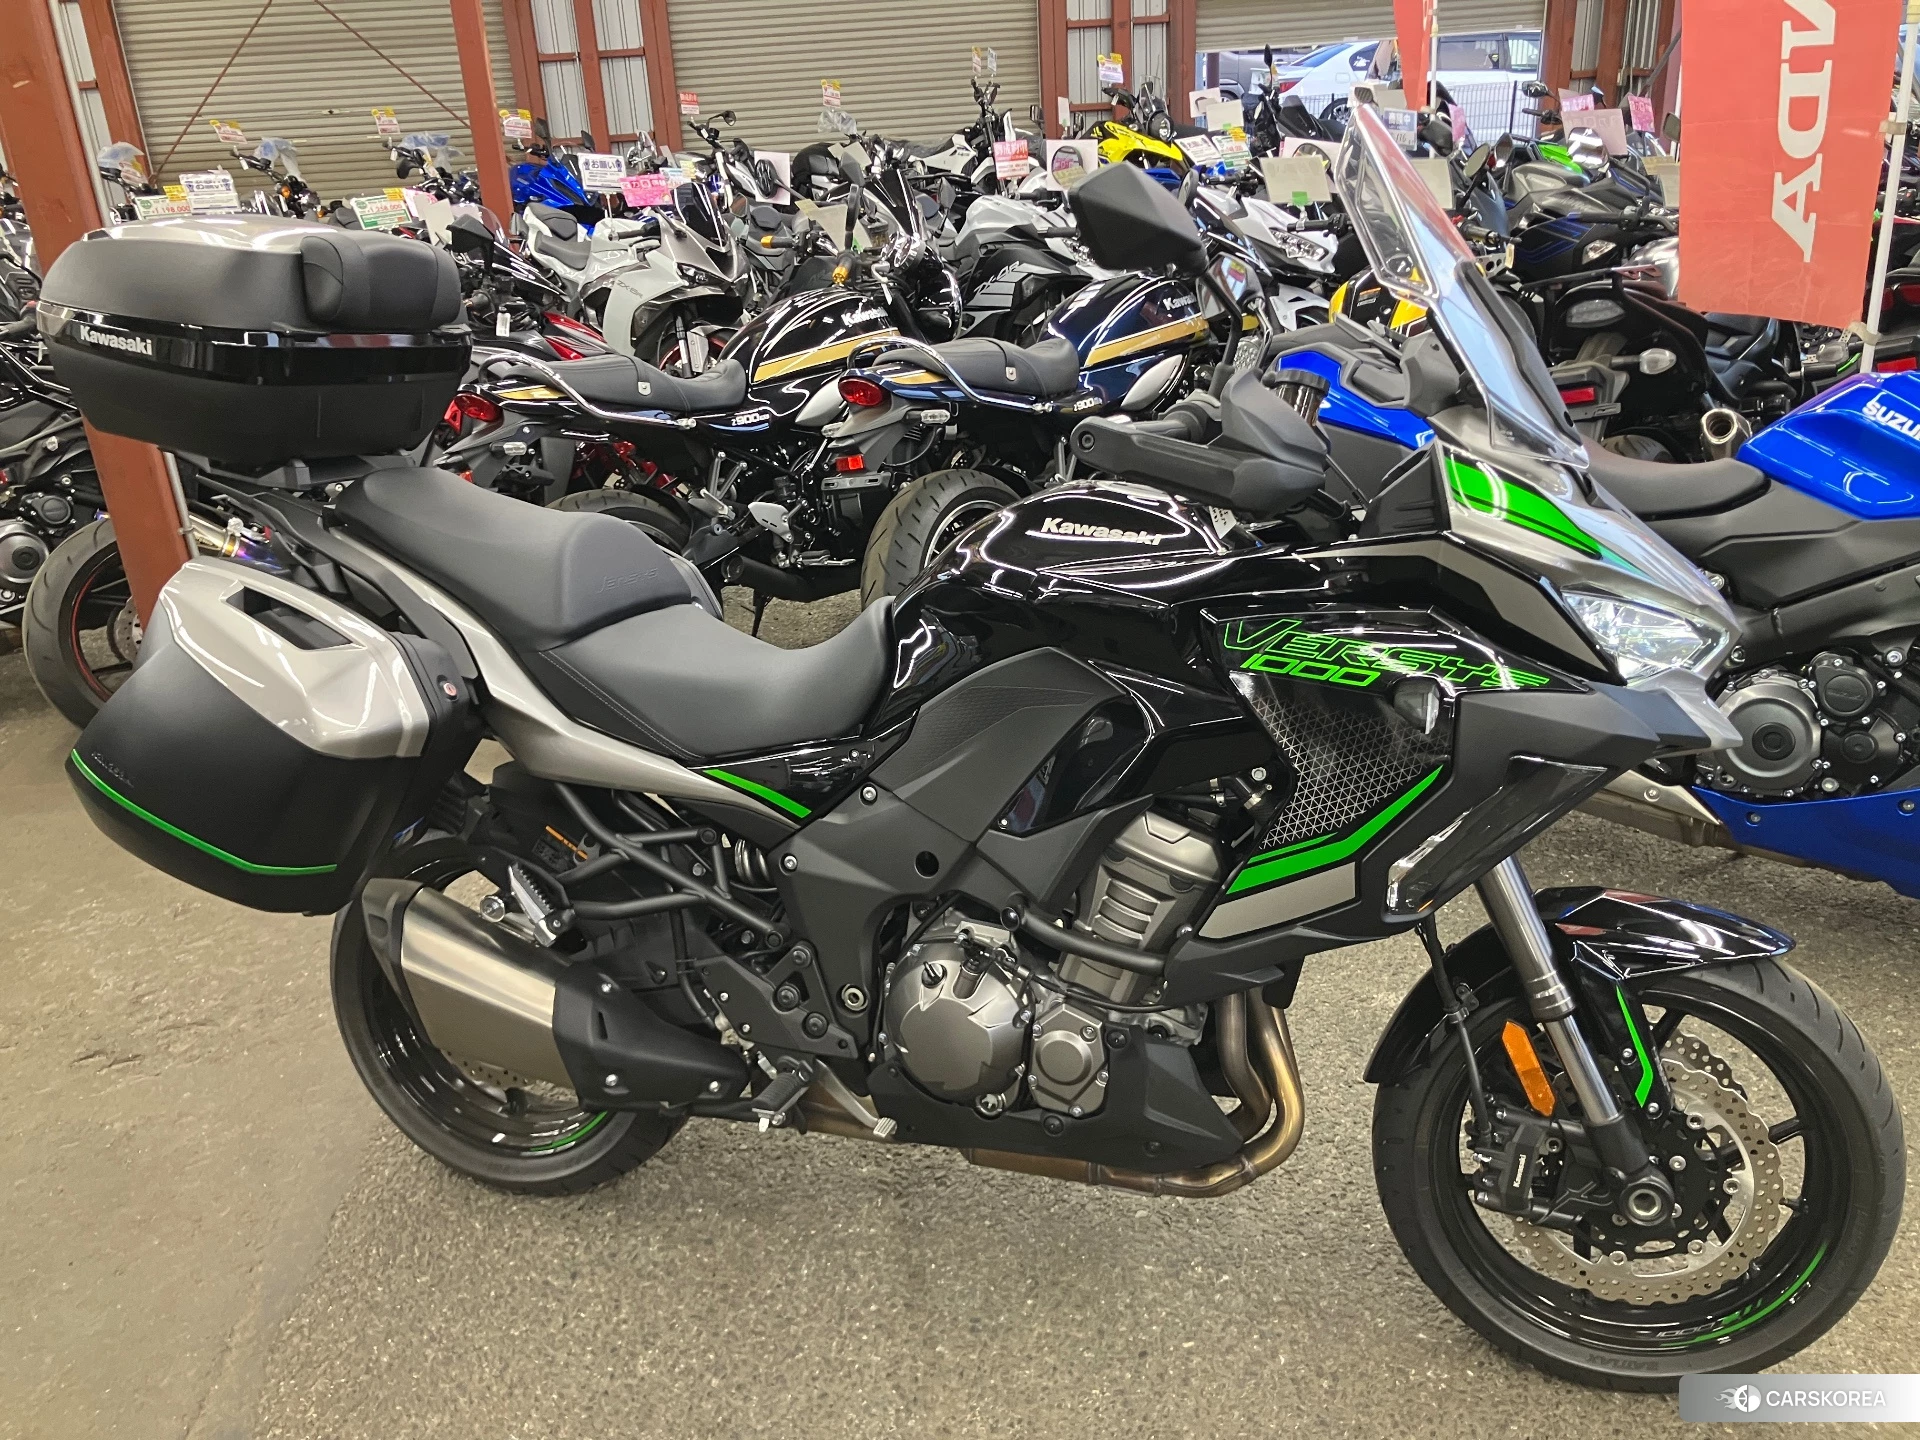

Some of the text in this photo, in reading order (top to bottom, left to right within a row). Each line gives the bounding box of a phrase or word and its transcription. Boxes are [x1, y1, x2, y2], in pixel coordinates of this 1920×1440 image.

[80, 324, 153, 356] Kawasaki
[1040, 517, 1162, 546] Kawasaki
[1239, 653, 1381, 687] 1000
